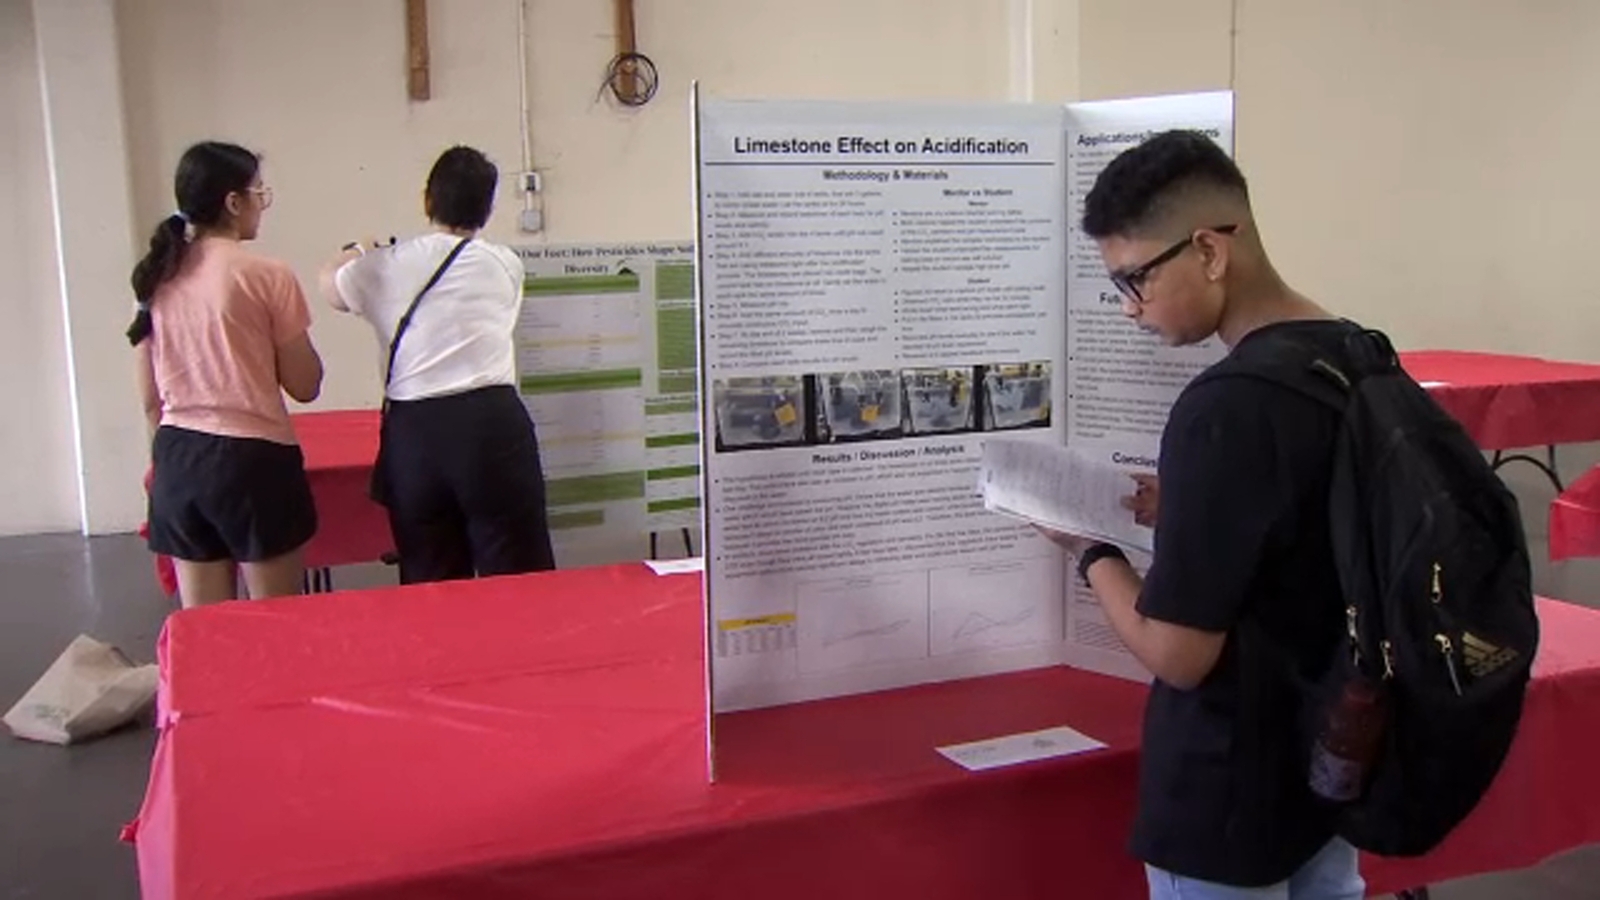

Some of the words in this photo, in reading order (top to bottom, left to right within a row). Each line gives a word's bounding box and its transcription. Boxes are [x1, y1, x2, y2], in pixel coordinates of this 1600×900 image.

[734, 136, 832, 154] Limestone
[837, 137, 889, 154] Effect
[894, 140, 916, 154] on
[922, 137, 1028, 154] Acidification
[823, 170, 890, 182] Methodology
[893, 170, 900, 180] &
[903, 170, 948, 180] Materials
[812, 453, 851, 464] Results
[859, 447, 916, 461] Discussion
[922, 444, 965, 457] Analysis
